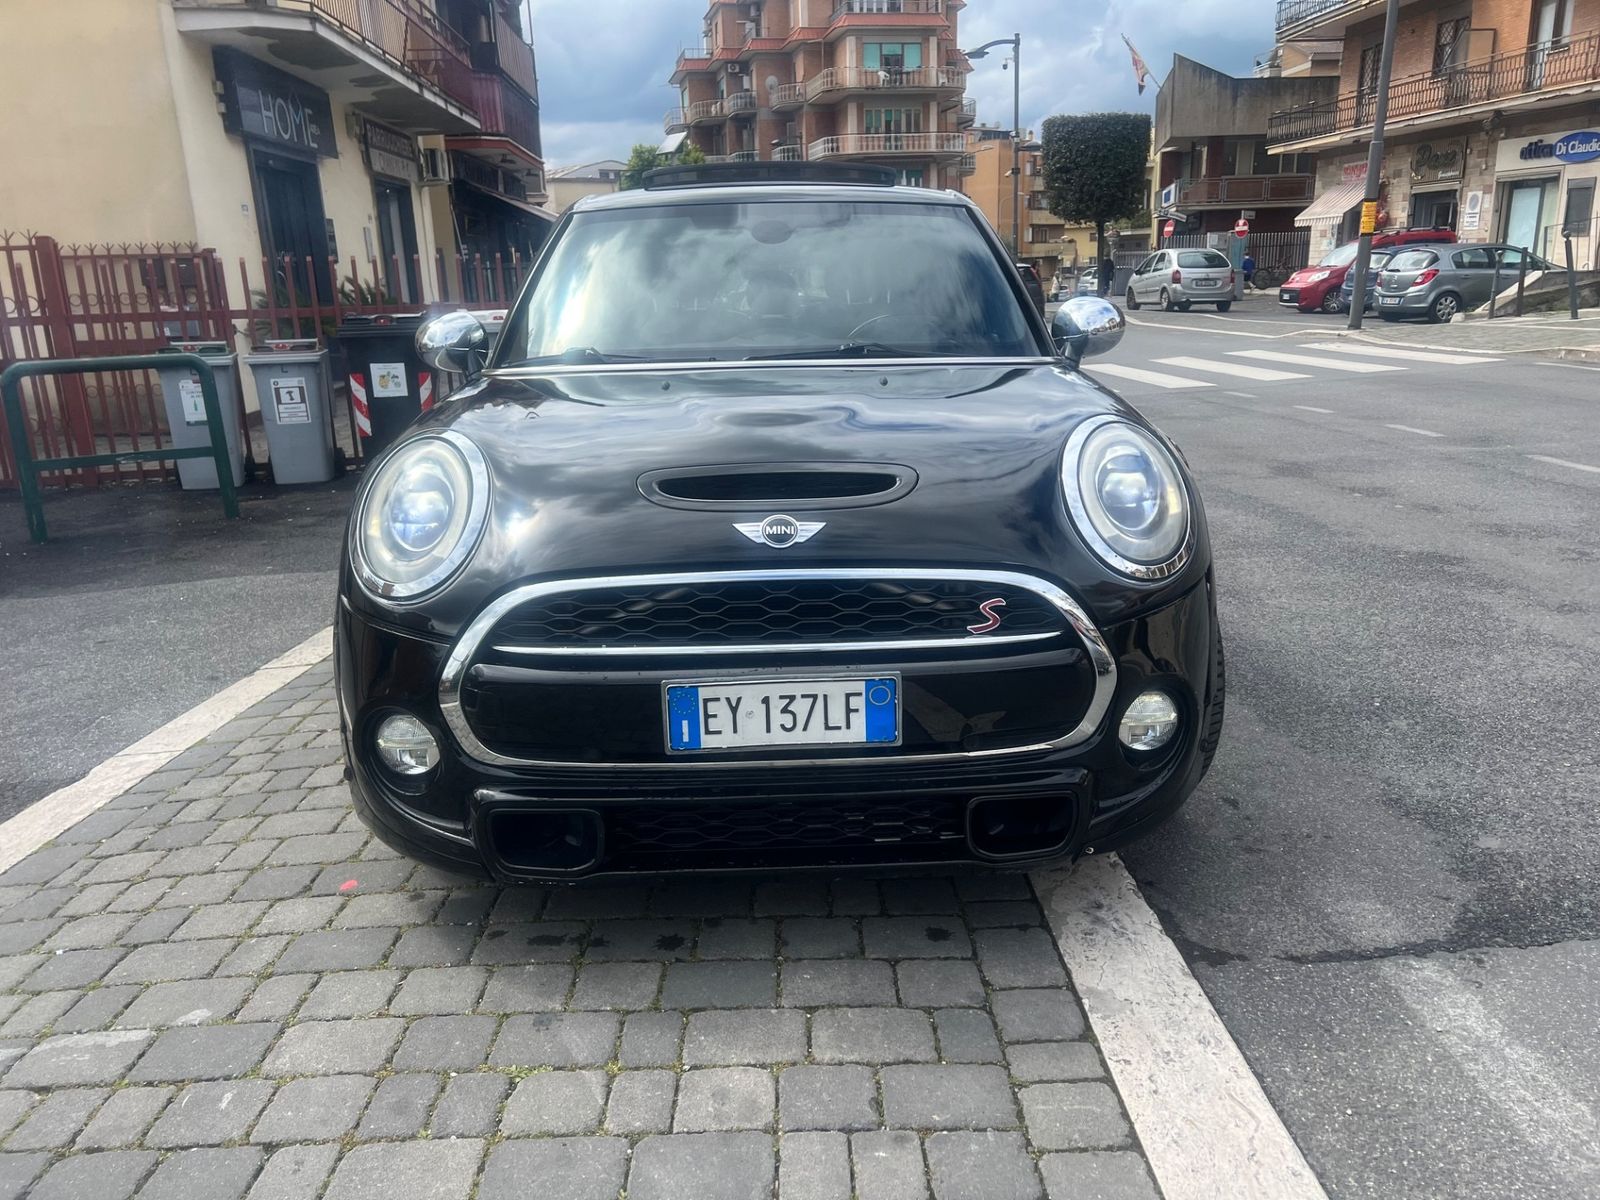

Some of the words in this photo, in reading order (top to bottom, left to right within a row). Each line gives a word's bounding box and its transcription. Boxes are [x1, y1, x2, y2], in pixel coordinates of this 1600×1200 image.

[257, 89, 319, 149] HOME
[1556, 143, 1567, 155] Di
[765, 525, 795, 535] MINI
[966, 597, 1006, 634] S
[702, 696, 742, 735] EY
[760, 692, 863, 734] 137LF
